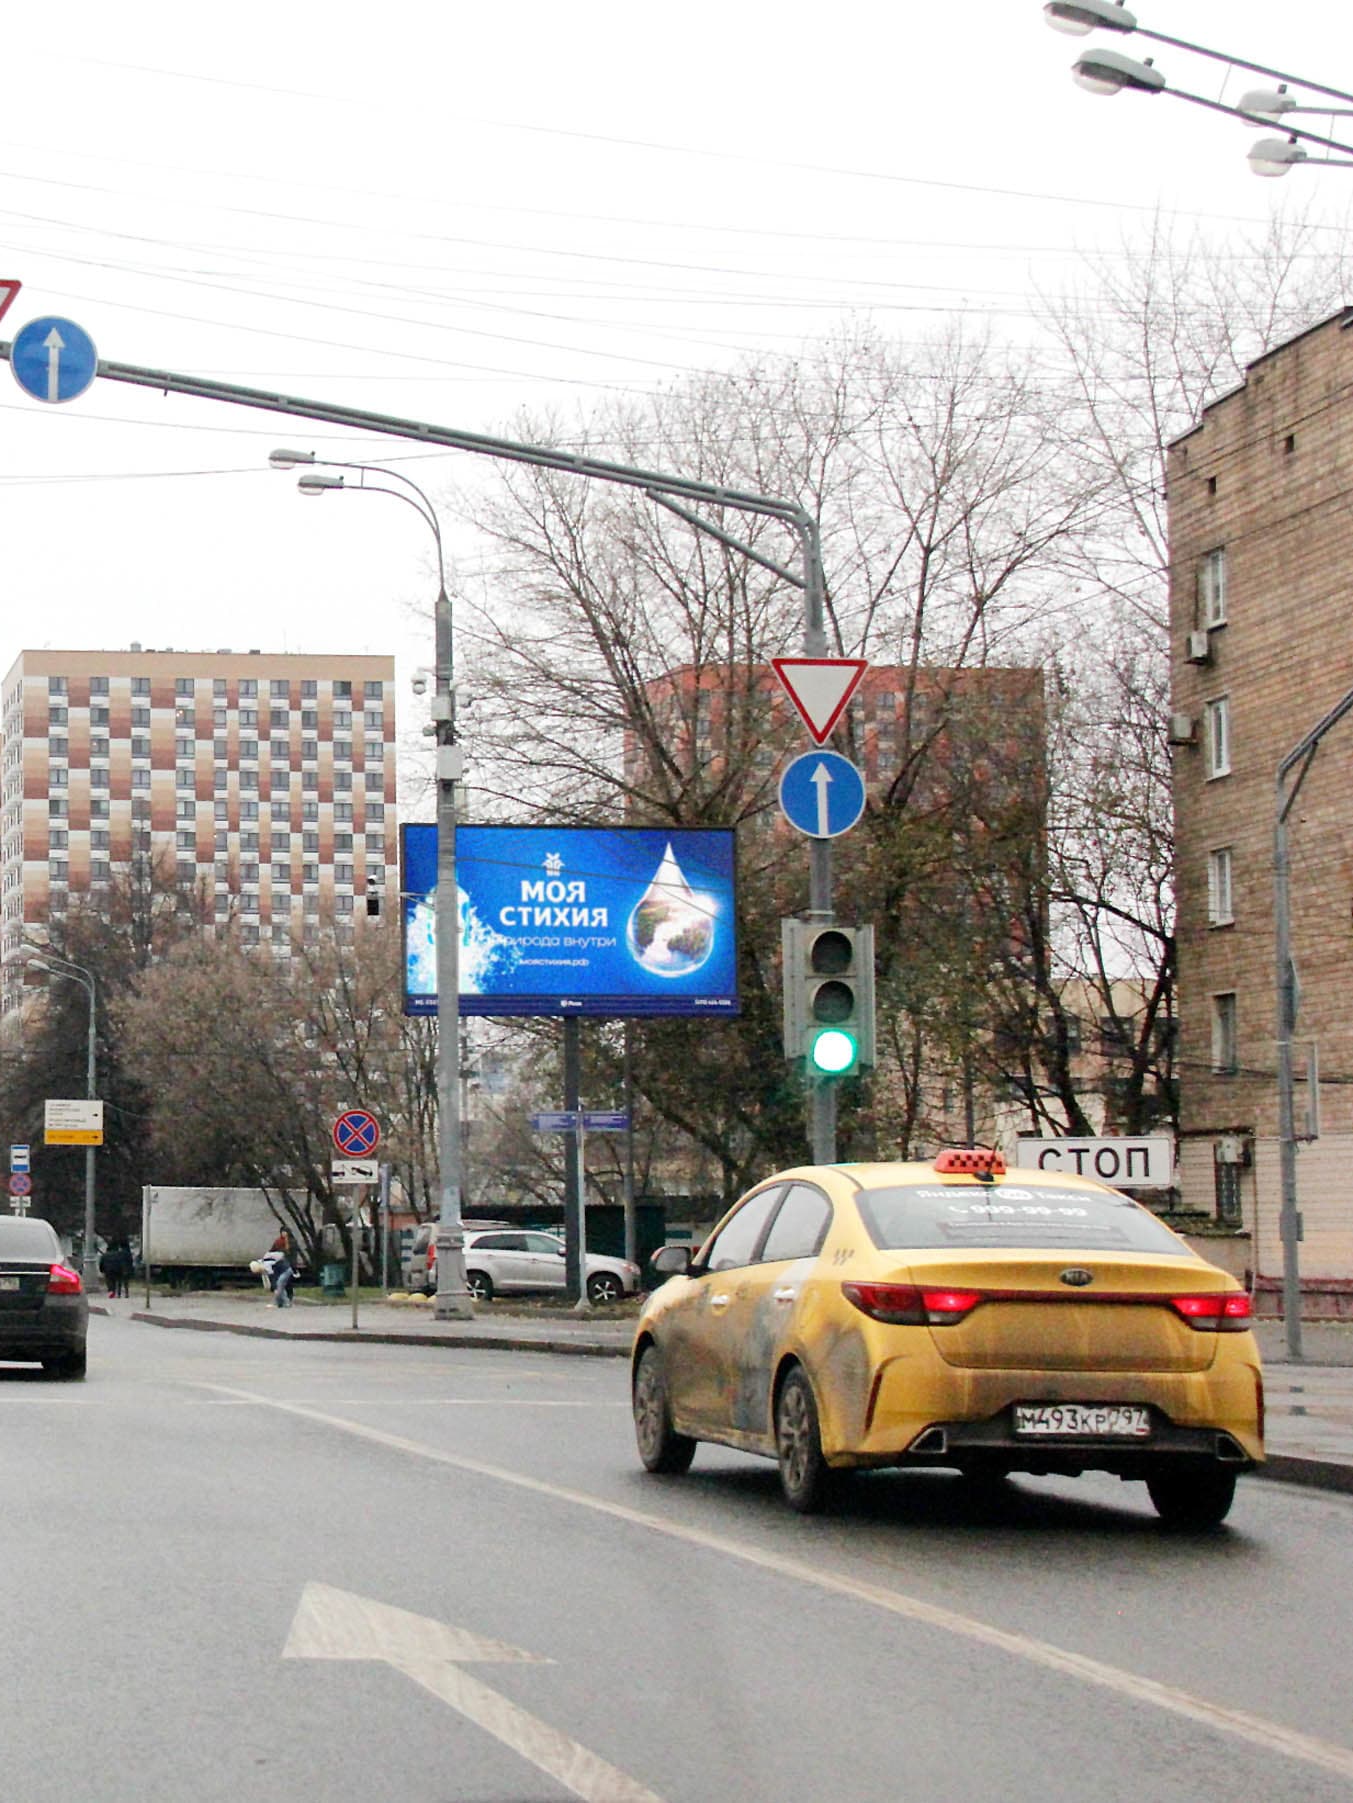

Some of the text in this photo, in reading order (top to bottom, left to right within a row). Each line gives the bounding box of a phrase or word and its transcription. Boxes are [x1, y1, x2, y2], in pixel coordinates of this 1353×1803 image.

[521, 880, 586, 903] МОЯ
[499, 906, 608, 928] СТИХИЯ
[563, 936, 617, 949] внутри
[1038, 1147, 1150, 1178] СТОП
